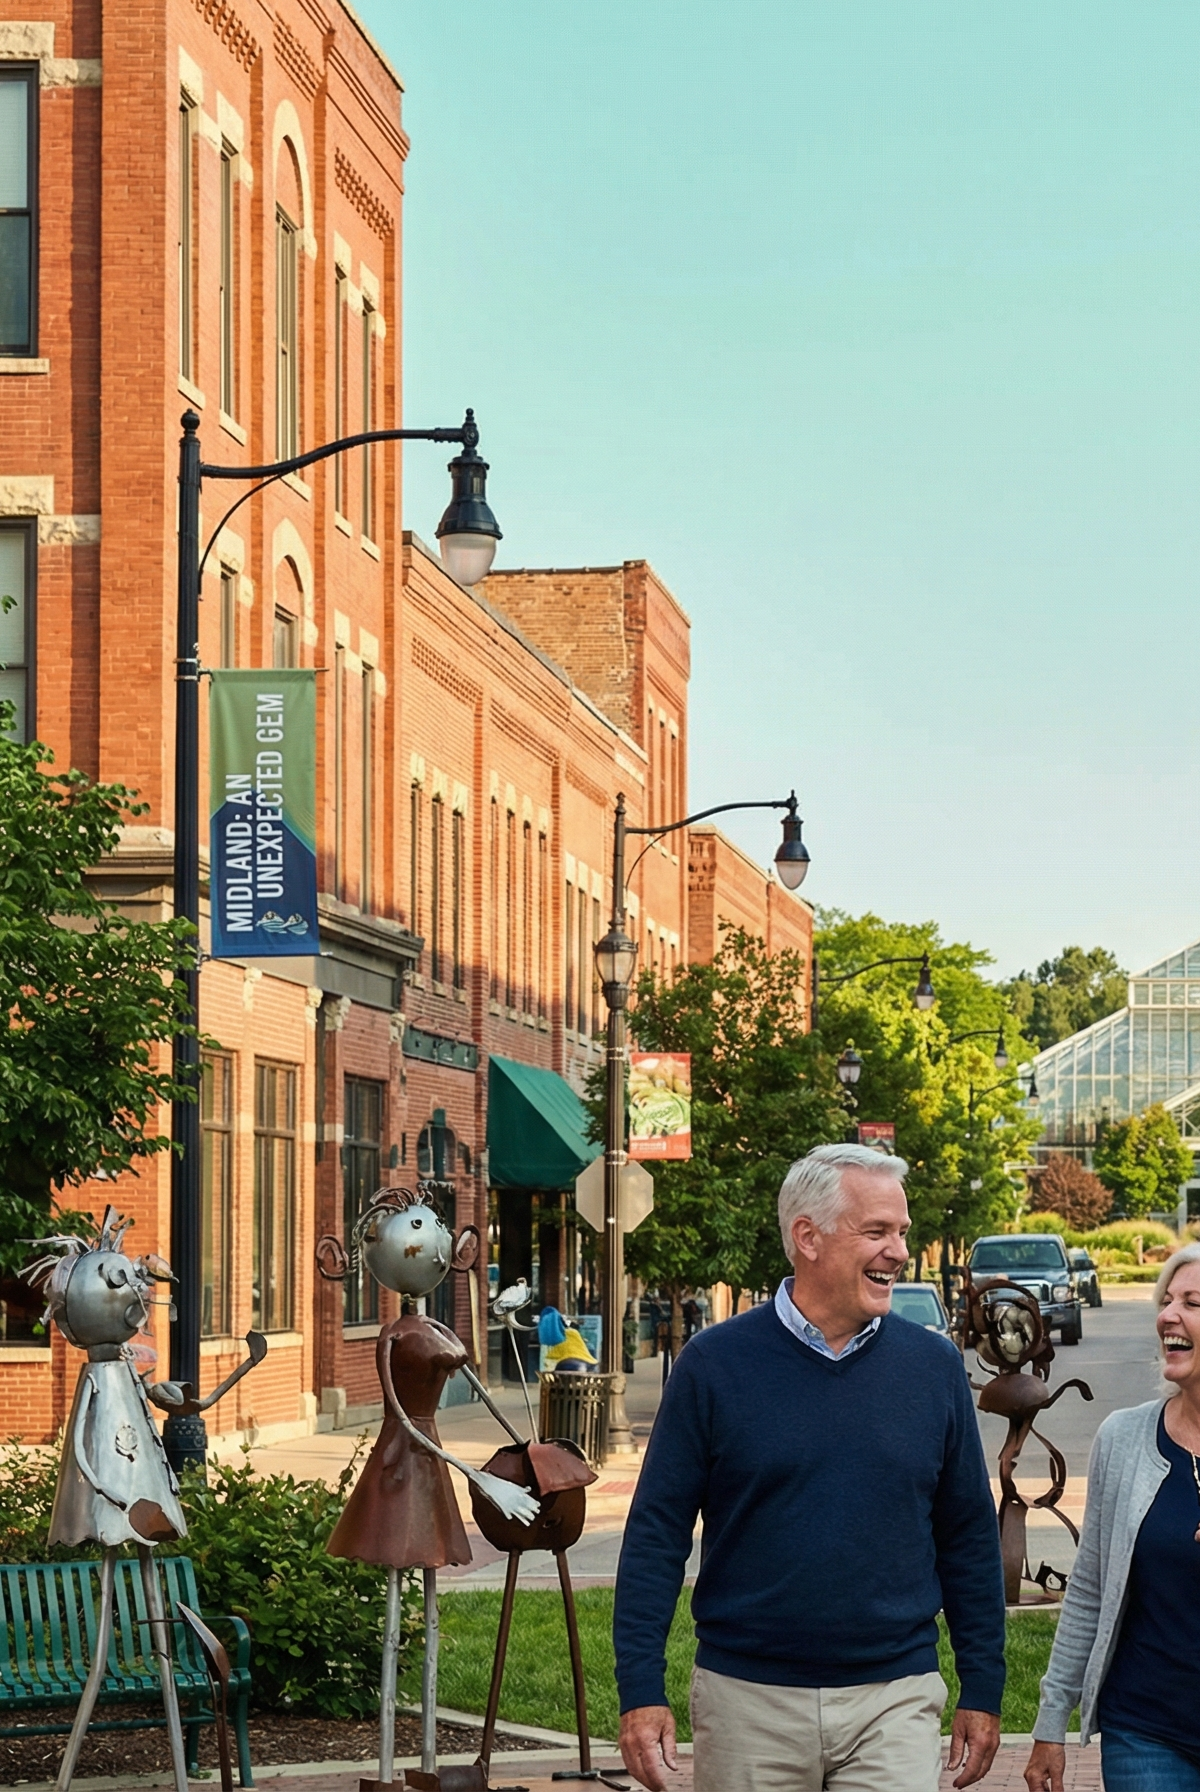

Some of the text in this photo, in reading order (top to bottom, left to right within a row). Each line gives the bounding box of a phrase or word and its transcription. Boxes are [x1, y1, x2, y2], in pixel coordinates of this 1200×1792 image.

[225, 774, 253, 932] MIDLAND: AN
[256, 694, 284, 898] UNEXPECTED GEM
